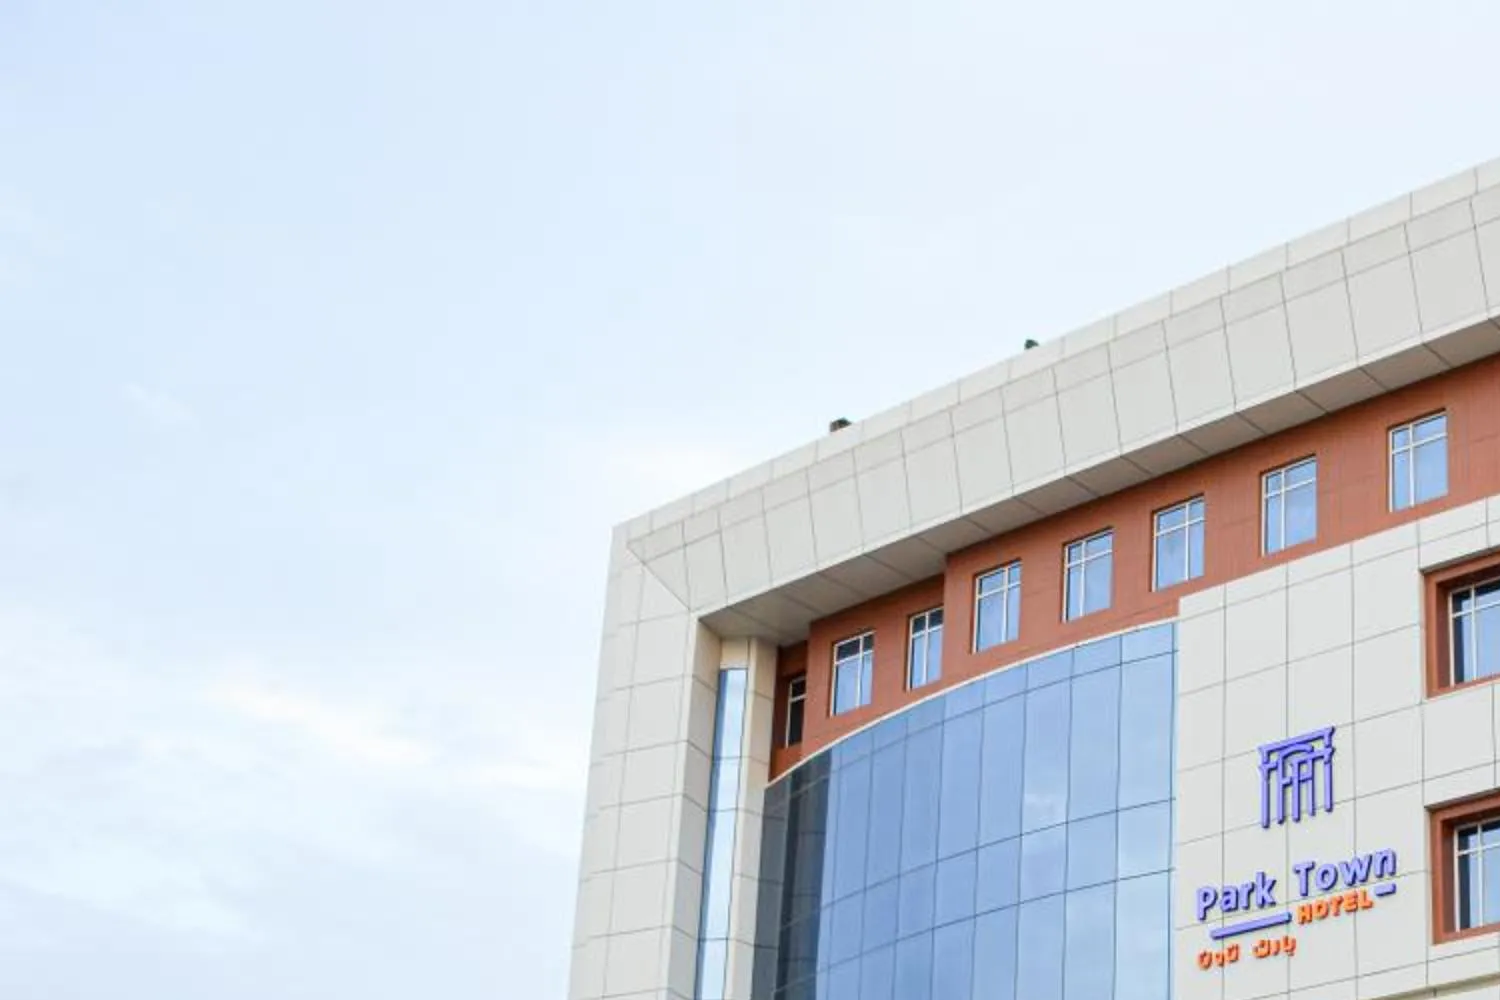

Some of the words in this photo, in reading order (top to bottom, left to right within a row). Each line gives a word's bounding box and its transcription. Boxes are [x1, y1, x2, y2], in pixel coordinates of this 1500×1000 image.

[1196, 871, 1277, 922] Park
[1294, 848, 1398, 897] Town
[1296, 889, 1374, 925] HOTEL
